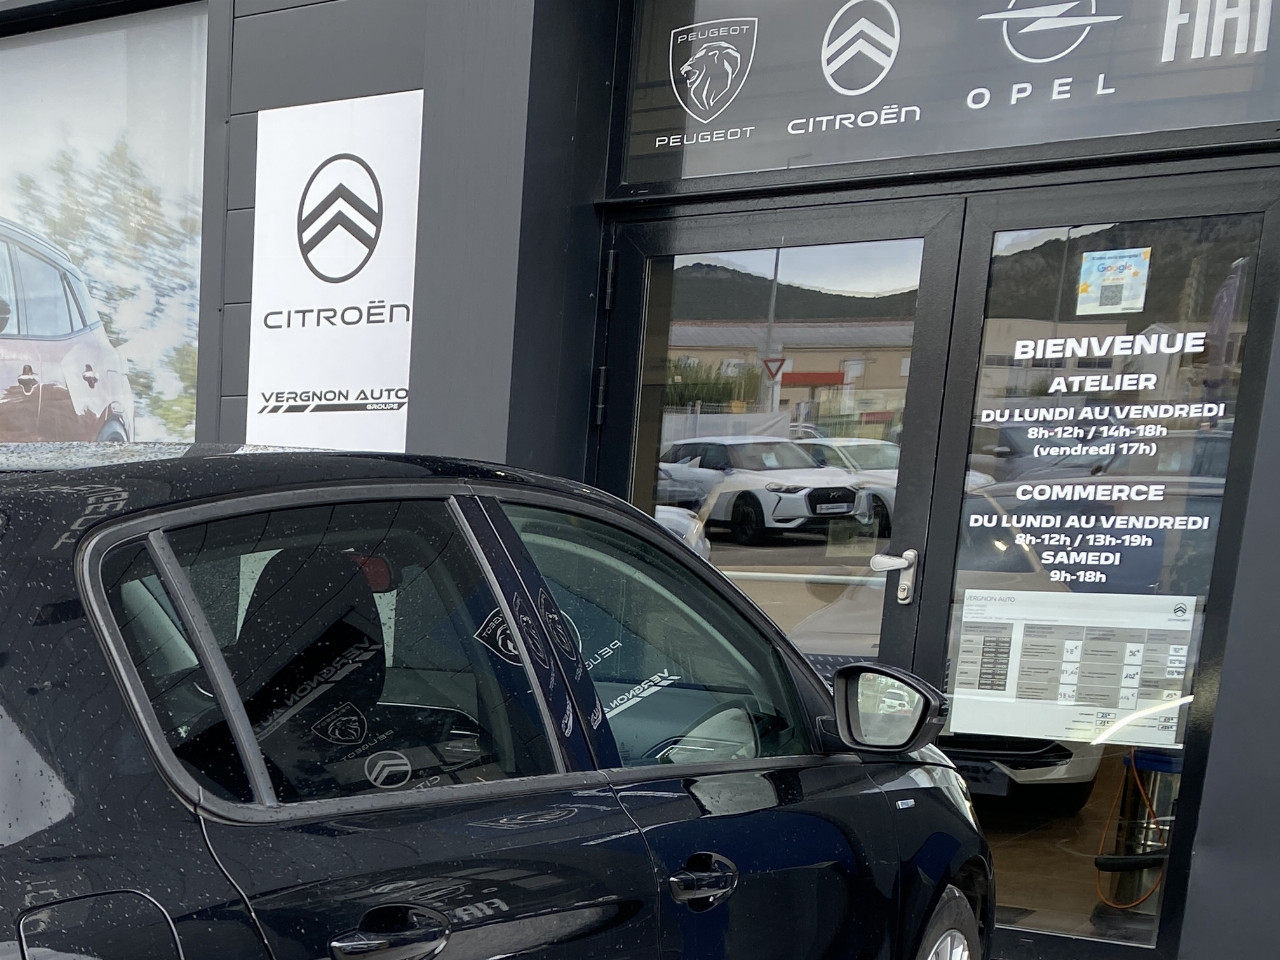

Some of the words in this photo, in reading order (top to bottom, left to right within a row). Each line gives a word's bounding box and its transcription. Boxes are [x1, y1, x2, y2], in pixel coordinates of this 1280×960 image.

[678, 26, 750, 44] PEUGEOT
[967, 74, 1116, 110] OPEL
[655, 126, 755, 147] PEUGEOT
[1097, 262, 1132, 273] Google
[1014, 332, 1207, 360] BIENVENUE
[1048, 374, 1158, 393] ATELIER
[261, 390, 349, 403] VERGNON
[354, 388, 408, 400] AUTO
[981, 409, 1010, 422] DU
[1014, 408, 1074, 422] LUNDI
[1078, 406, 1110, 420] AU
[1114, 404, 1225, 418] VENDREDI
[1027, 426, 1084, 438] 8h-12h
[1087, 426, 1097, 440] /
[1100, 424, 1168, 438] 14h-18h
[1034, 444, 1116, 458] (vendredi
[1118, 442, 1157, 457] 17h)
[1016, 484, 1166, 502] COMMERCE
[970, 514, 998, 528] DU
[1002, 515, 1061, 528] LUNDI
[1065, 516, 1096, 528] AU
[1100, 516, 1210, 530] VENDREDI
[1014, 534, 1070, 545] 8h-12h
[1073, 534, 1082, 547] /
[1086, 535, 1152, 547] 13h-19h
[1041, 552, 1120, 566] SAMEDI
[1050, 570, 1107, 583] 9h-18h
